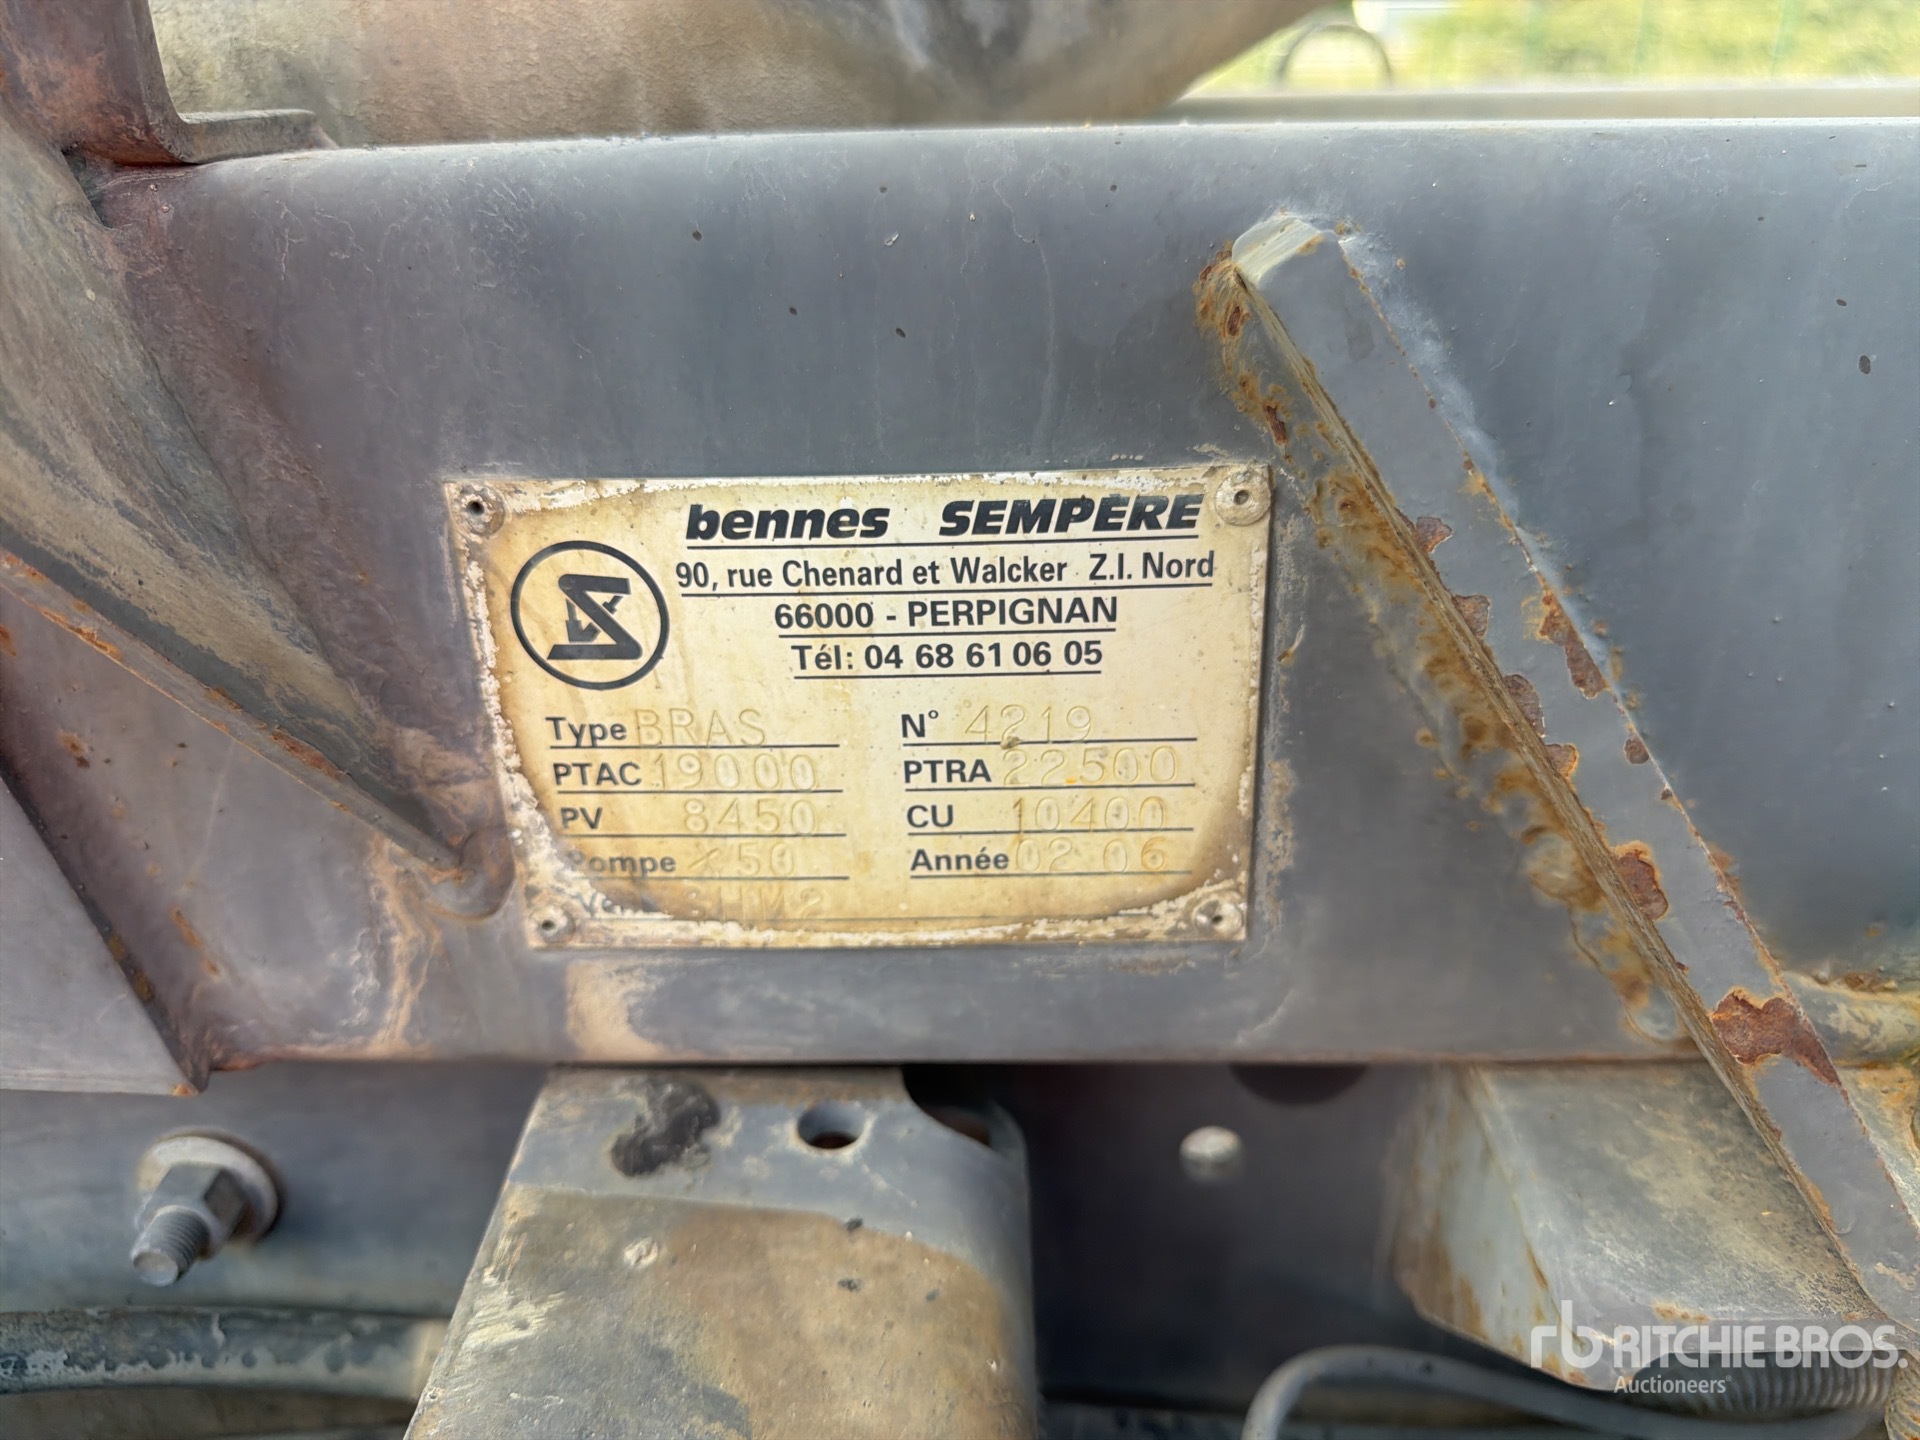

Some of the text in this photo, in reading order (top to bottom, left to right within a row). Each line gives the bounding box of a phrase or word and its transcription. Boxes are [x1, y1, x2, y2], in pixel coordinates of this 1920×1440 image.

[686, 504, 890, 540] bennes
[675, 549, 1215, 591] 90, rue Chenard et Walcker Z.I. Nord
[774, 602, 874, 629] 66000
[907, 596, 1118, 628] PERPIGNAN
[791, 639, 1102, 671] Tél: 04 68 61 06 05
[545, 707, 768, 748] Type BRAS
[901, 704, 1092, 743] N° 4219
[553, 752, 818, 791] PTAC 19000
[903, 745, 1177, 787] PTRA 22500
[560, 797, 818, 836] PV 8450
[906, 796, 1167, 832] CU 10400
[910, 837, 1166, 873] Année 02 06
